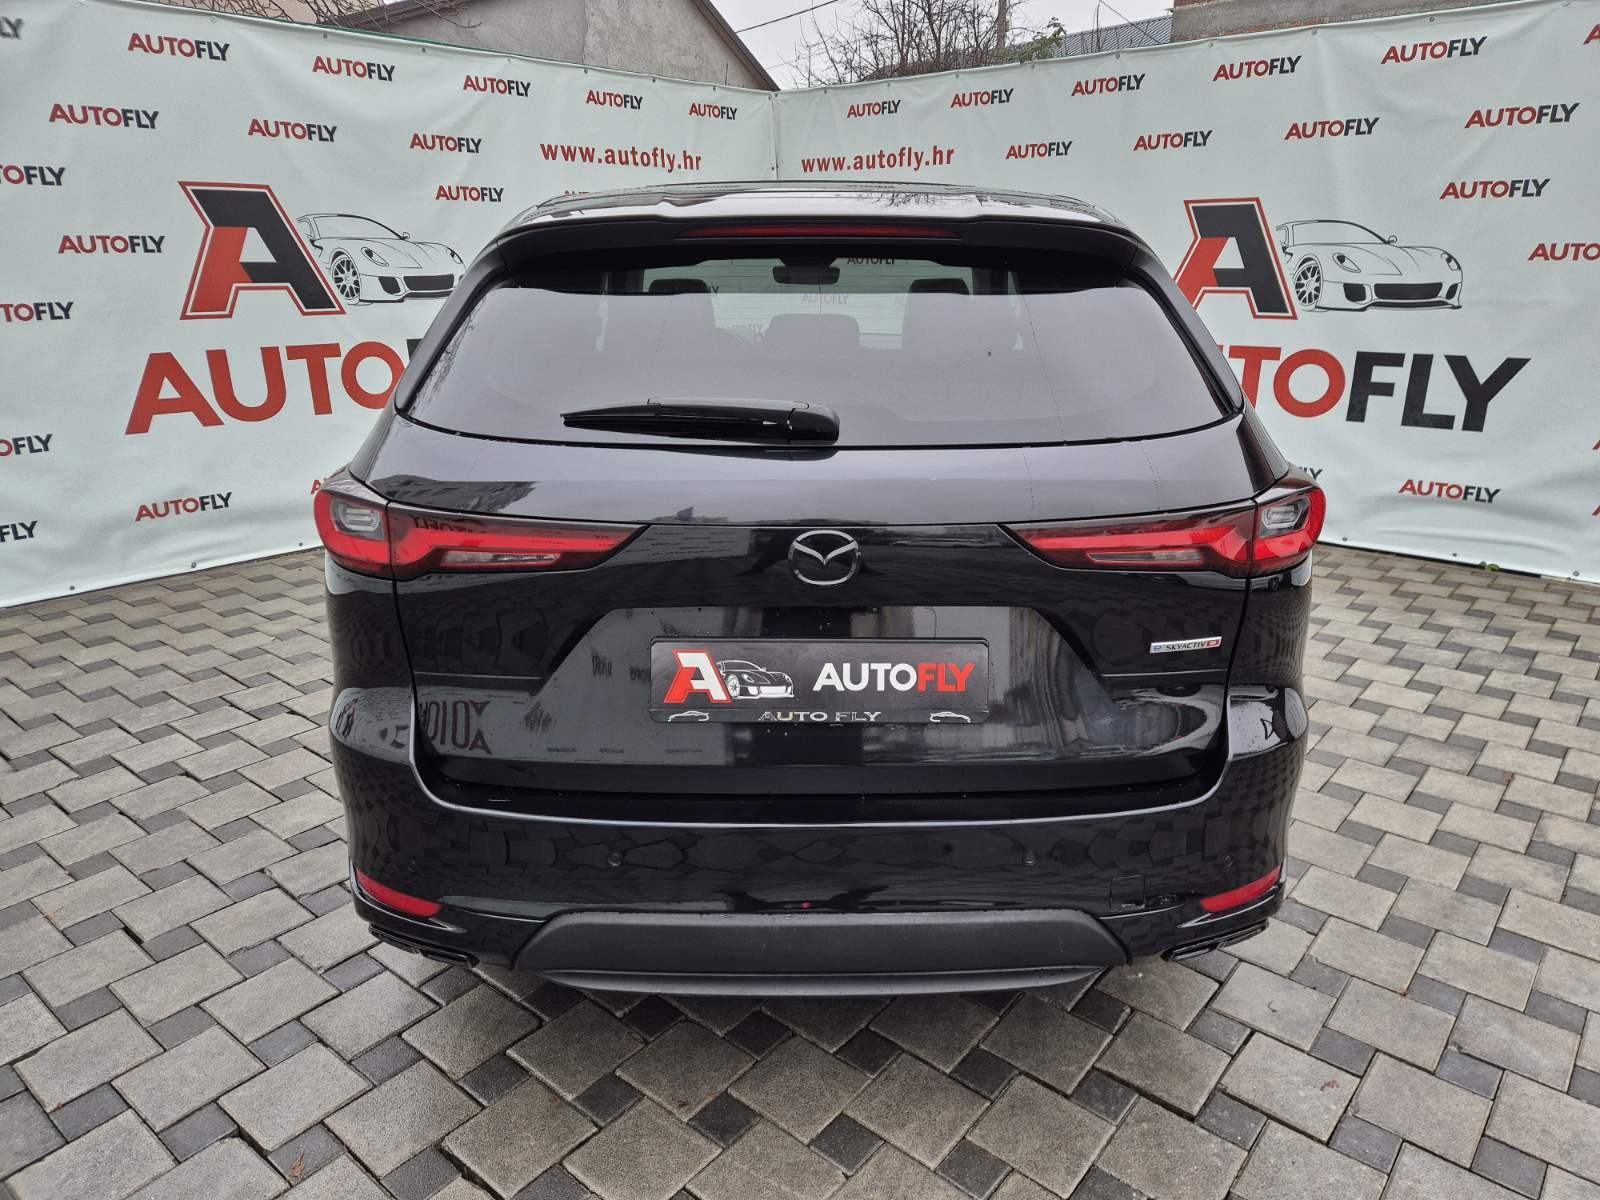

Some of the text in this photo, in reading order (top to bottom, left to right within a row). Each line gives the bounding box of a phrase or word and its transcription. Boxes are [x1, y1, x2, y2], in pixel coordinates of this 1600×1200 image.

[128, 33, 230, 61] AUTOFLY
[1381, 36, 1487, 64] AUTOFLY
[312, 56, 395, 81] AUTOFLY
[1213, 56, 1302, 81] AUTOFLY
[463, 75, 531, 97] AUTOFLY
[1071, 74, 1146, 96] AUTOFLY
[586, 90, 643, 110] AUTOFLY
[847, 100, 901, 118] AUTOFLY
[951, 88, 1014, 108] AUTOFLY
[49, 103, 159, 129] AUTOFLY
[689, 102, 737, 120] AUTOFLY
[1464, 103, 1580, 128] AUTOFLY
[248, 119, 337, 142] AUTOFLY
[1284, 117, 1379, 140] AUTOFLY
[410, 133, 481, 153] AUTOFLY
[1006, 141, 1072, 159] AUTOFLY
[1134, 130, 1212, 151] AUTOFLY
[540, 143, 701, 173] www.autofly.hr
[801, 145, 954, 172] www.autofly.hr
[0, 165, 65, 186] OFLY
[436, 185, 504, 202] AUTOFLY
[1440, 179, 1550, 200] AUTOFLY
[58, 235, 165, 255] AUTOFLY
[125, 339, 420, 435] AUTO
[1217, 344, 1531, 432] TOFLY
[1399, 479, 1501, 503] AUTOFLY
[135, 492, 232, 521] AUTOFLY
[1165, 641, 1206, 651] SKYACTIV
[812, 662, 977, 693] AUTOFLY
[758, 711, 881, 722] AUTO FLY
